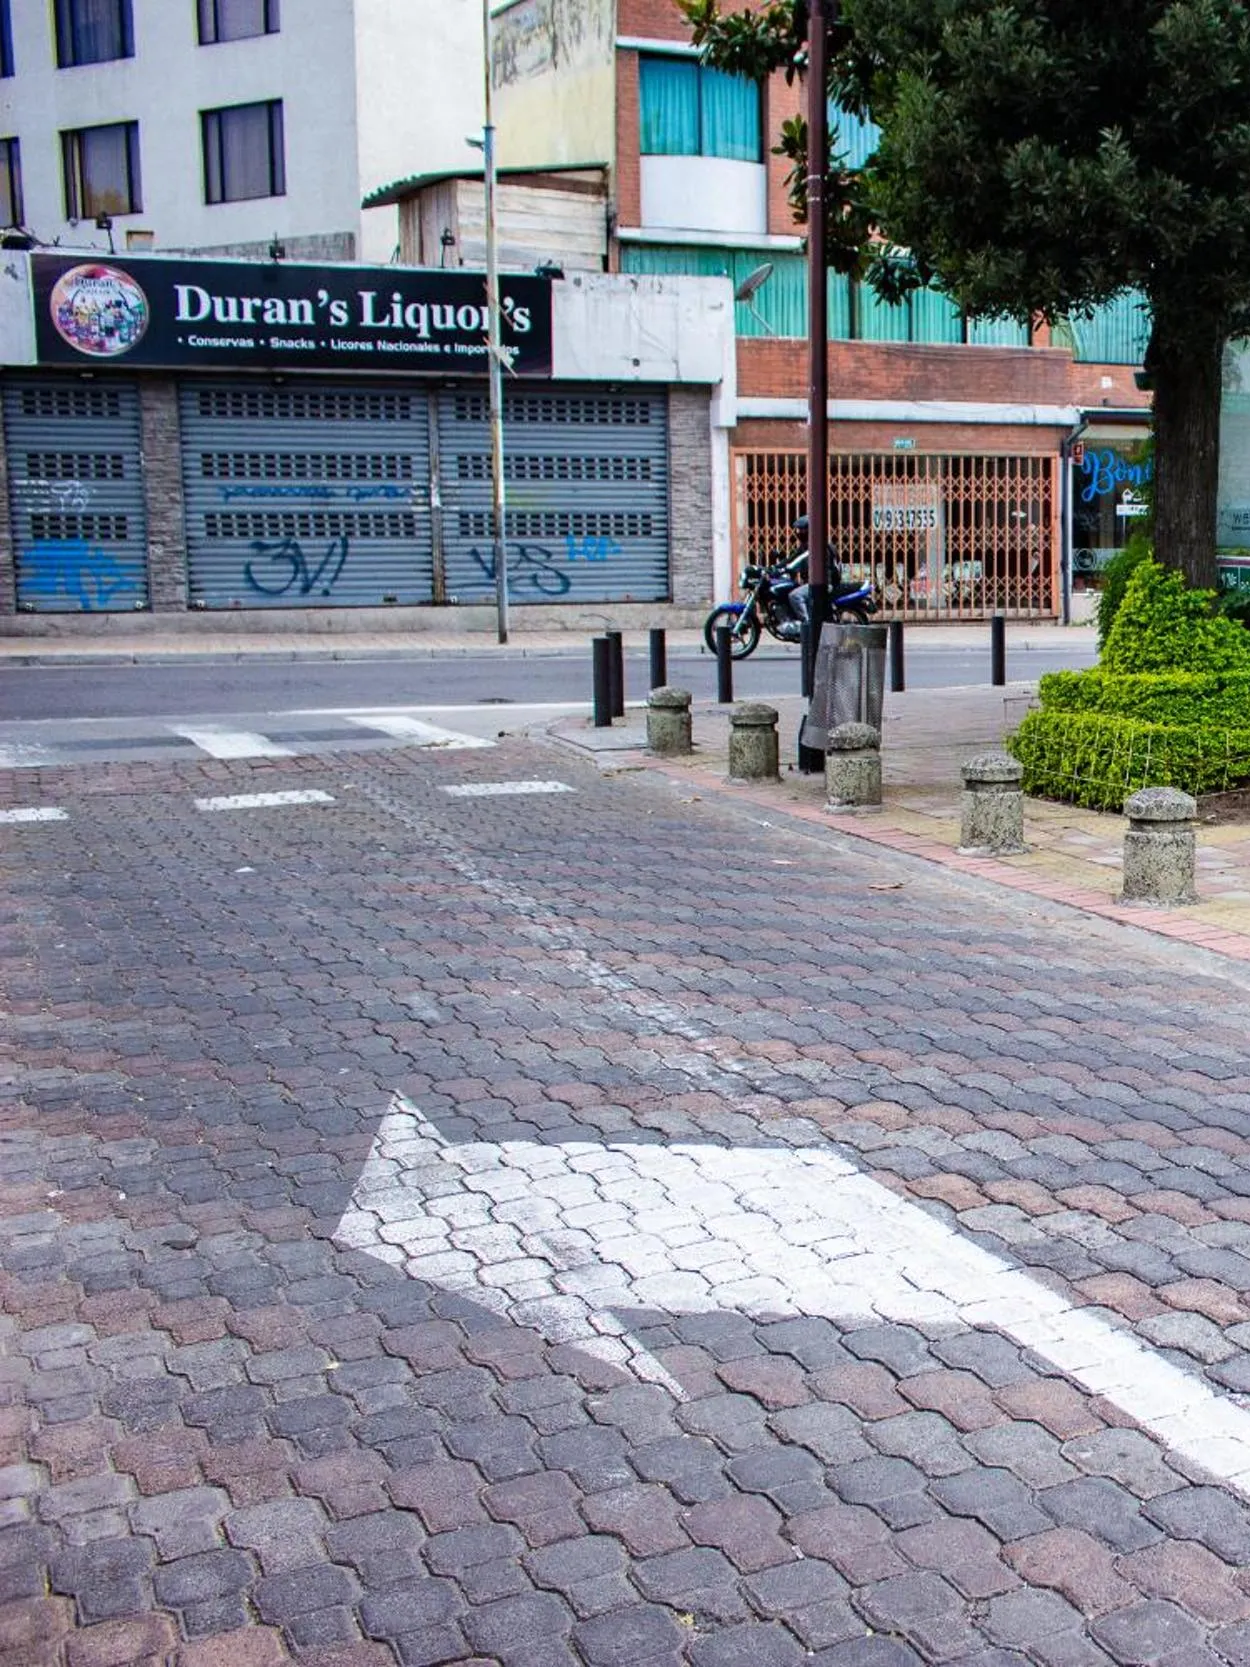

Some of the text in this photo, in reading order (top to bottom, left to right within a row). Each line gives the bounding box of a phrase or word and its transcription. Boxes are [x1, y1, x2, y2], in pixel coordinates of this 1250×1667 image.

[173, 284, 350, 328] Duran's
[188, 335, 255, 348] Conservas
[270, 337, 316, 350] Snacks
[330, 338, 373, 351] Licores
[377, 340, 441, 353] Nacionales
[444, 344, 451, 353] e
